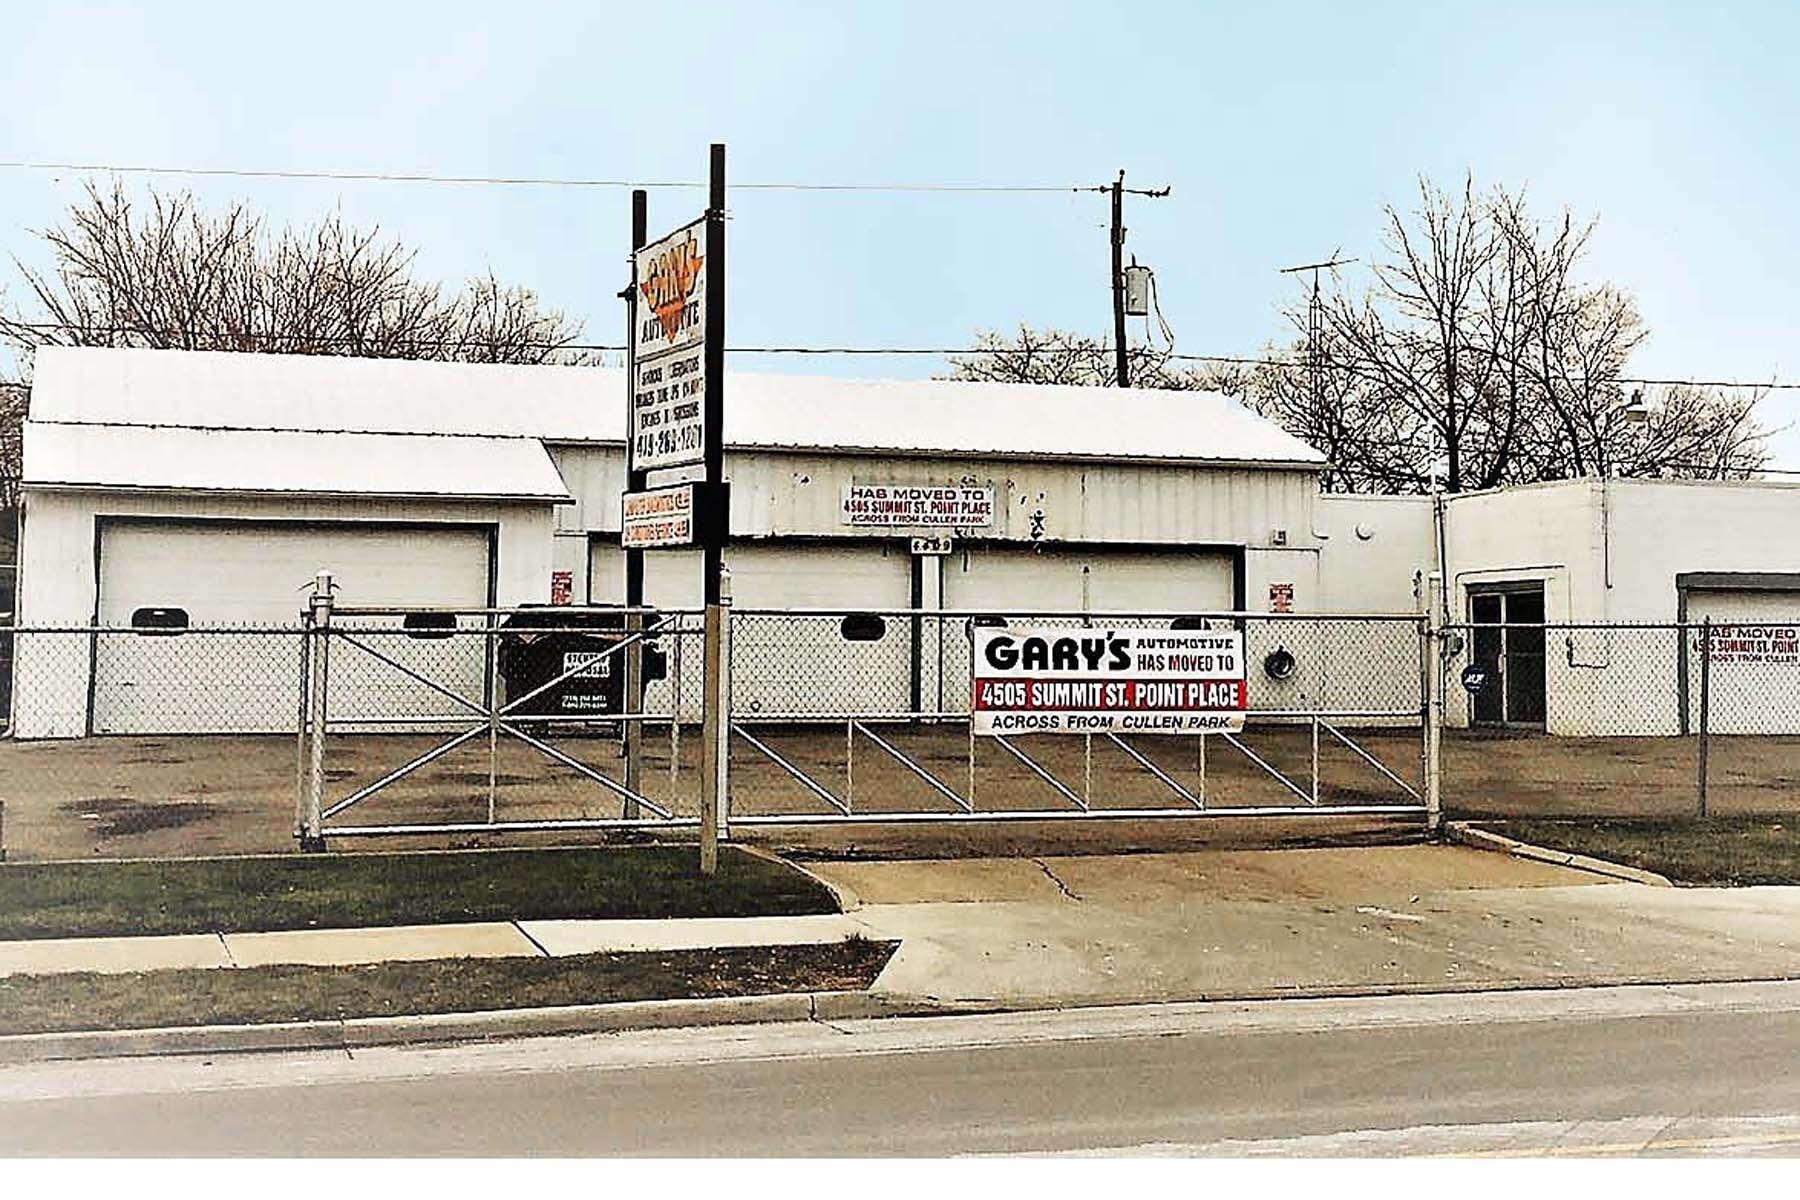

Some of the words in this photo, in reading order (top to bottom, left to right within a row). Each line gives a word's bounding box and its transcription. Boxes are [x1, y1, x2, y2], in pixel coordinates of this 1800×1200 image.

[641, 300, 699, 344] AUTTIVE
[893, 489, 957, 500] MOVED
[961, 490, 984, 500] TO
[871, 500, 912, 514] SUMMIT
[914, 501, 928, 514] ST.
[930, 501, 960, 514] POINT
[961, 501, 992, 515] PLACE
[1736, 627, 1796, 639] MOVED
[984, 631, 1131, 671] GARY'S
[1136, 638, 1234, 649] AUTOMOTIVE
[1692, 639, 1716, 652] 455
[1137, 654, 1165, 671] HAS
[1168, 654, 1213, 672] MOVED
[1216, 654, 1234, 671] TO
[981, 682, 1026, 706] 4505
[1031, 682, 1104, 708] SUMMIT
[1105, 682, 1130, 708] ST.
[1134, 682, 1185, 708] POINT
[1188, 682, 1239, 708] PLACE
[992, 715, 1060, 729] ACROSS
[1067, 715, 1113, 729] FROM
[1122, 716, 1183, 729] CULLEN
[1188, 716, 1230, 729] PARK
